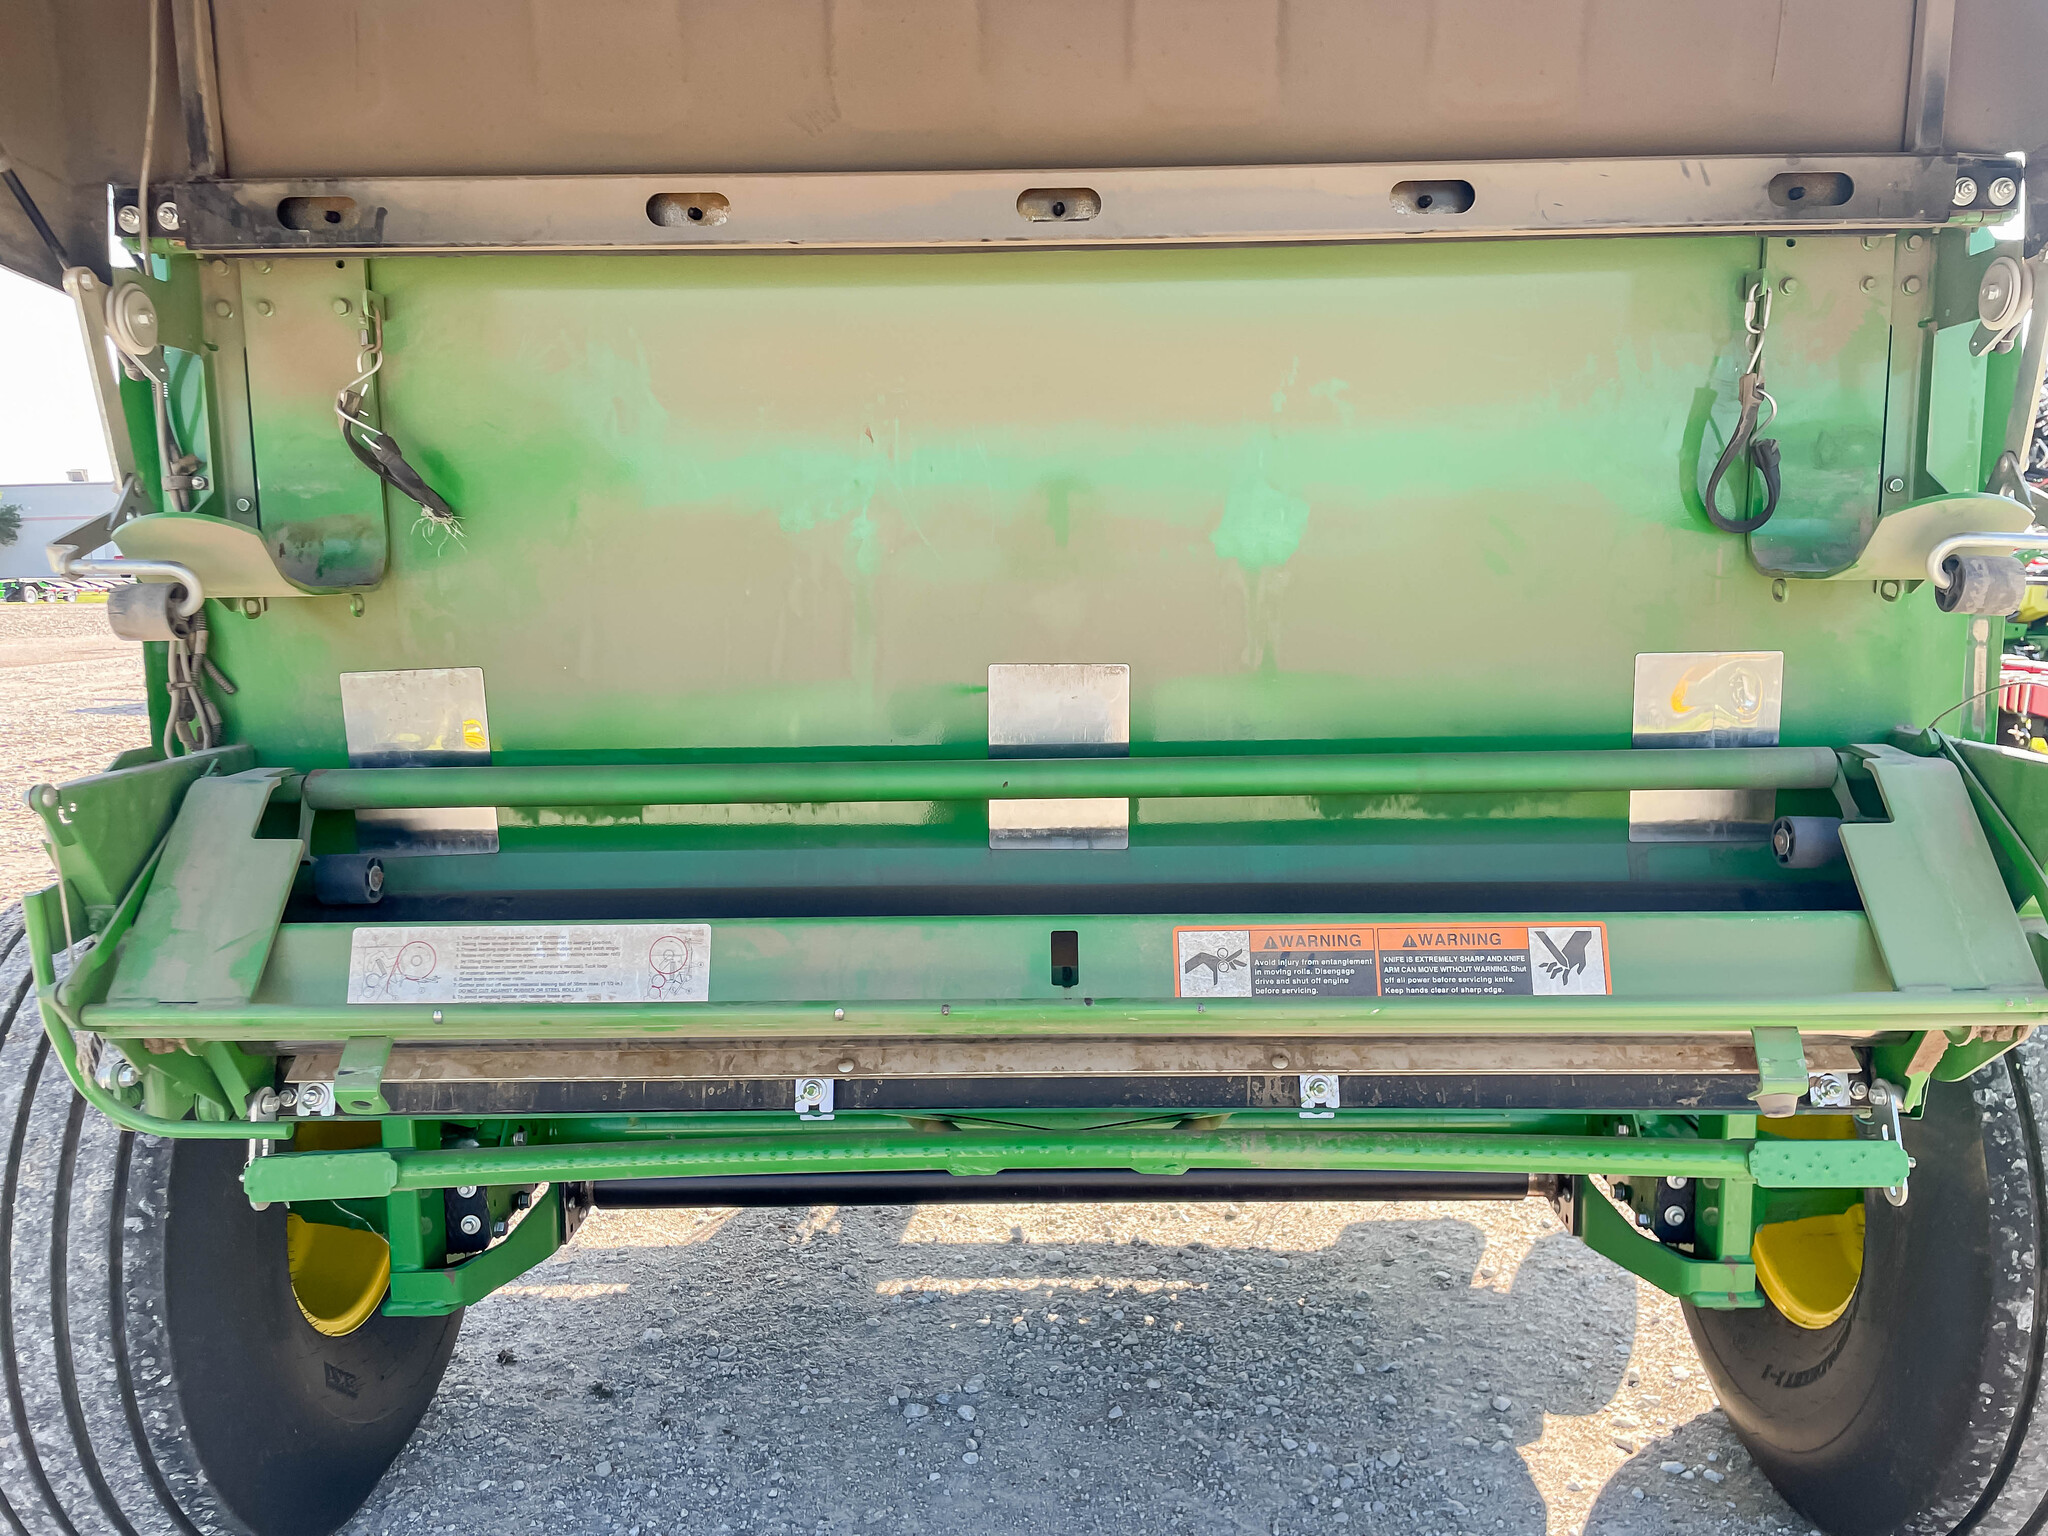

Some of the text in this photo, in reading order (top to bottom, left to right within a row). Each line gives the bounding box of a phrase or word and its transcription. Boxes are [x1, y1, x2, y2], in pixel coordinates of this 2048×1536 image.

[1278, 934, 1362, 948] WARNING
[1418, 933, 1502, 946] WARNING
[1254, 957, 1373, 968] Avoid injury from entanglement
[1383, 955, 1404, 963] KNIFE
[1406, 955, 1413, 963] IS
[1415, 955, 1458, 963] EXTREMELY
[1460, 955, 1485, 963] SHARP
[1263, 968, 1292, 977] moving
[1315, 967, 1355, 977] Disengage
[1292, 977, 1308, 985] shut
[1323, 977, 1349, 986] engine
[1384, 976, 1395, 984] off
[1396, 976, 1406, 984] all
[1407, 977, 1430, 985] power
[1432, 976, 1455, 984] before
[1459, 976, 1493, 985] servicing
[1281, 986, 1319, 996] servicing.
[1385, 987, 1404, 995] Keep
[1461, 987, 1482, 995] sharp
[1484, 987, 1505, 995] edge.
